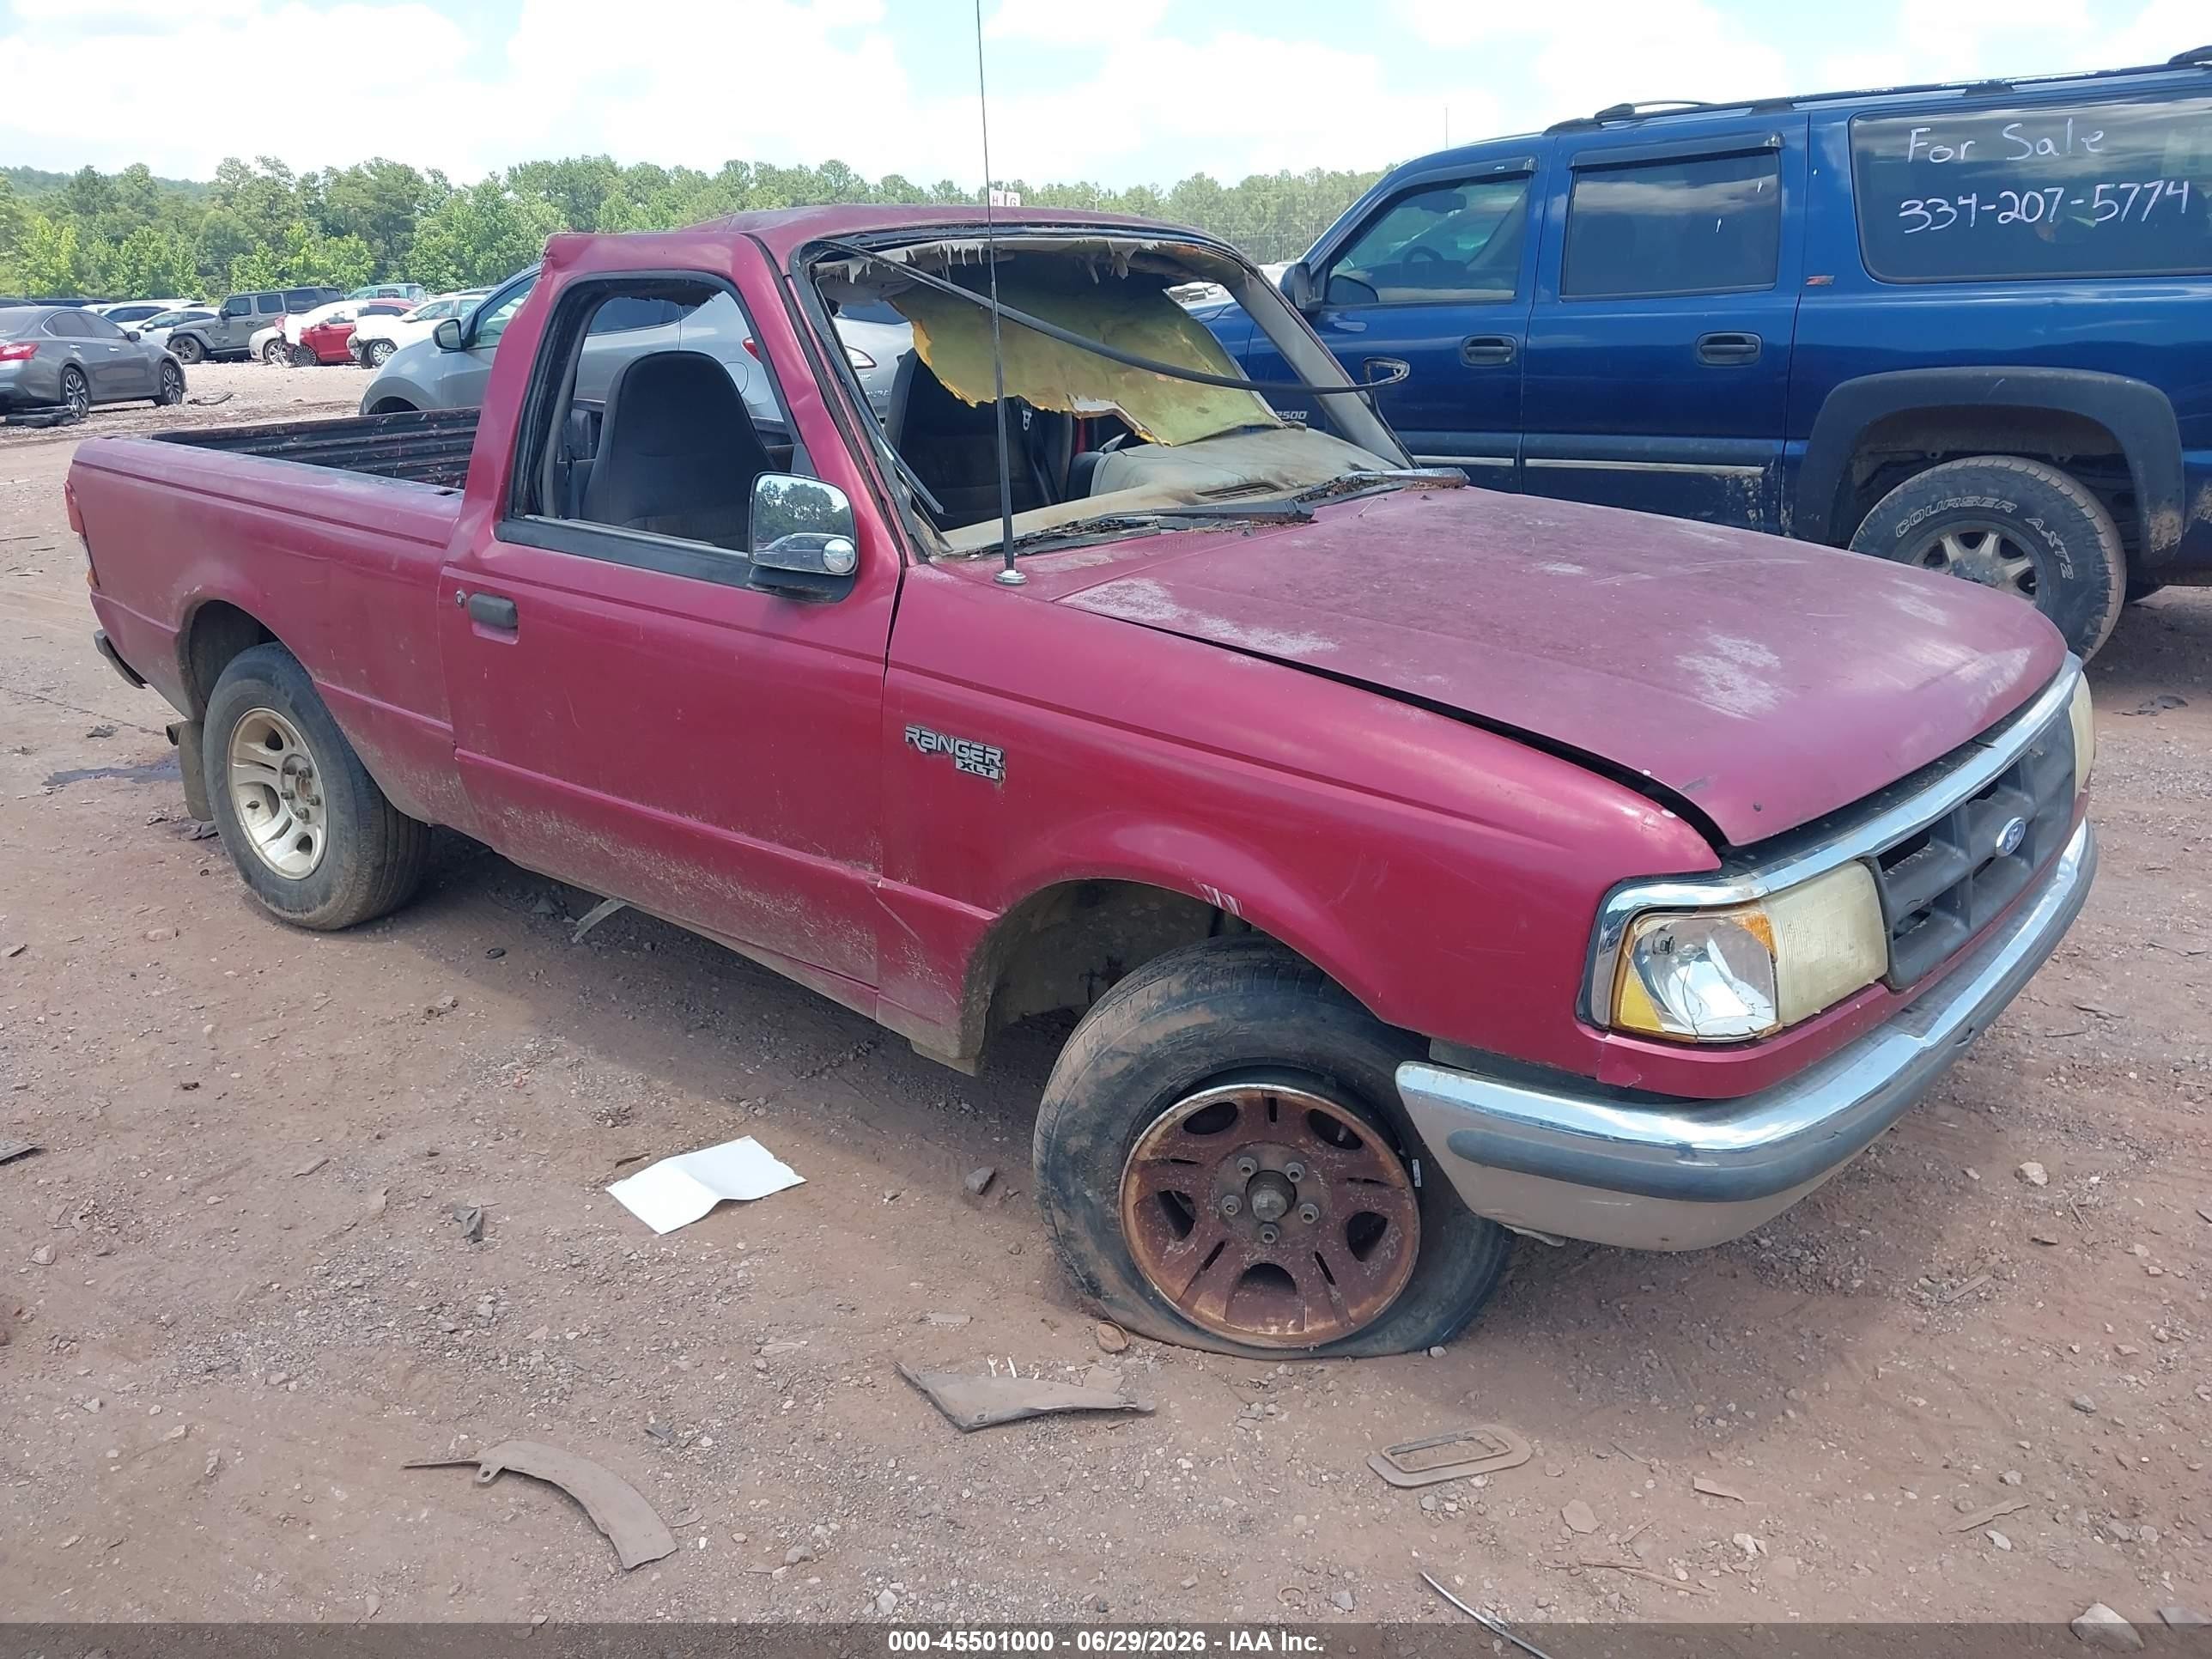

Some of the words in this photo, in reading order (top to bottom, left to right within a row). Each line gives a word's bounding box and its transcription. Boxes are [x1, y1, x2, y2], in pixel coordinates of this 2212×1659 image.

[1908, 127, 1976, 163] For
[2002, 117, 2105, 161] Sale
[1898, 179, 2190, 234] 334-207-5774
[1895, 495, 2018, 538] COURSER
[959, 760, 994, 776] XLT
